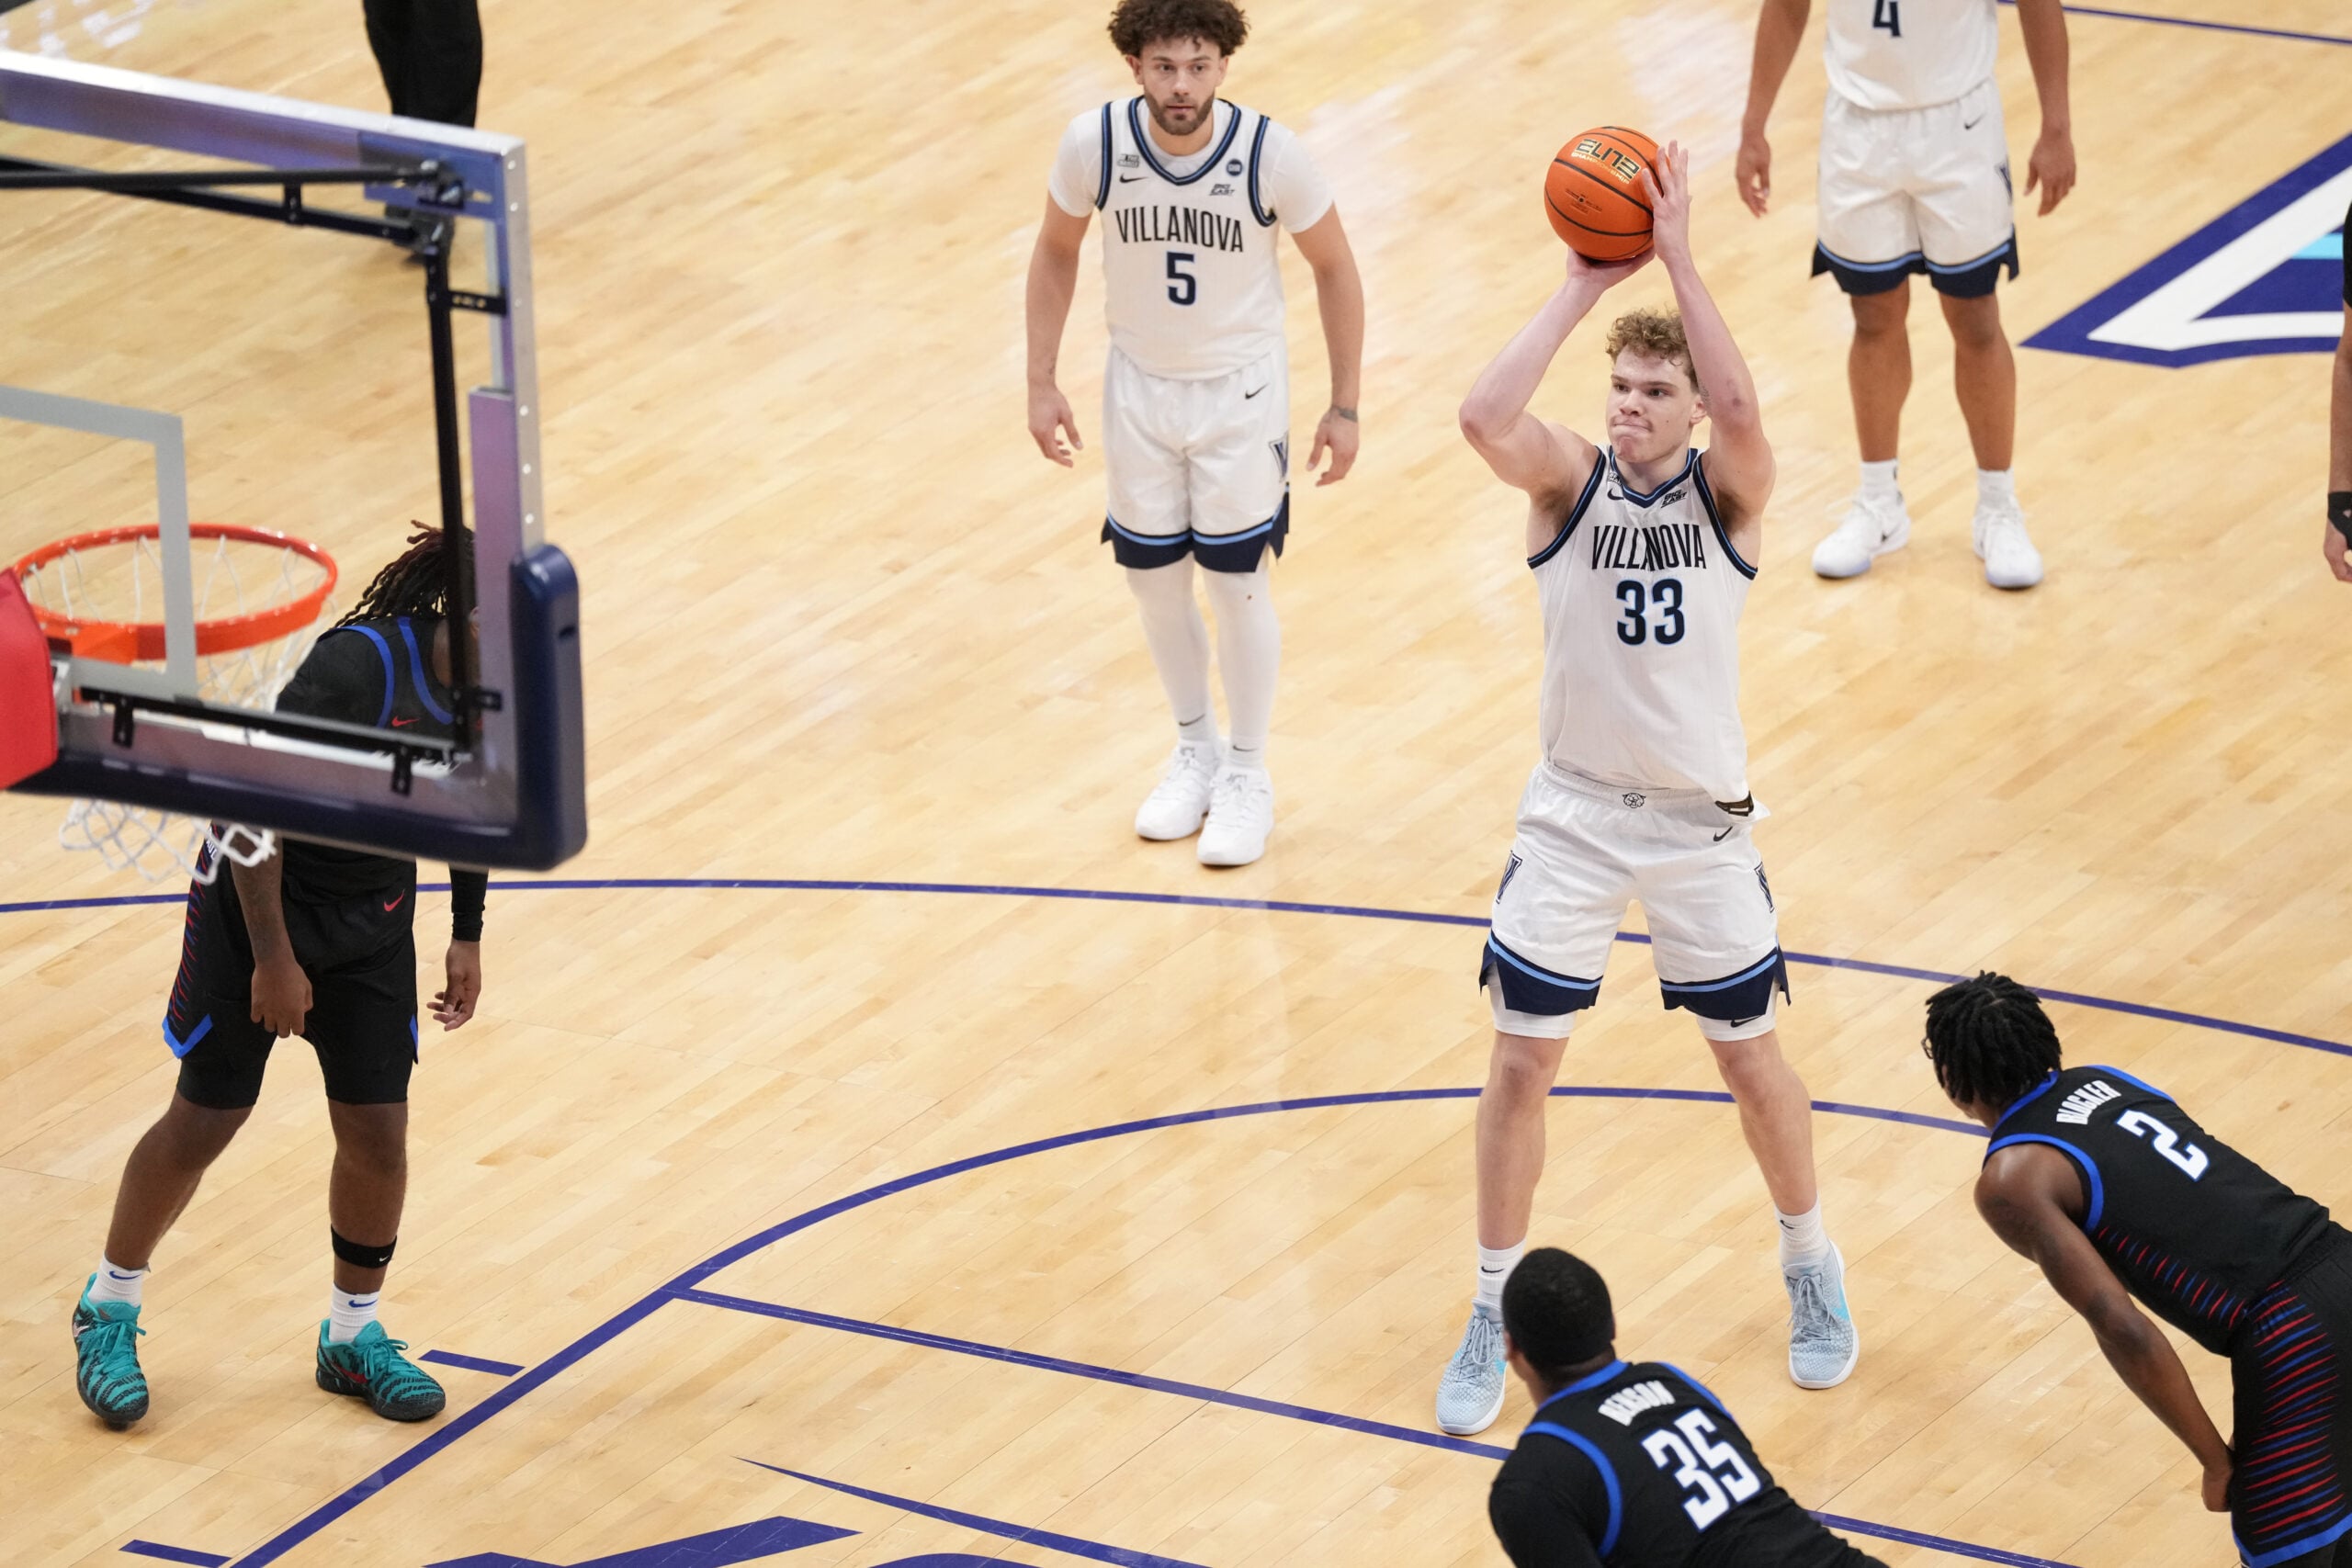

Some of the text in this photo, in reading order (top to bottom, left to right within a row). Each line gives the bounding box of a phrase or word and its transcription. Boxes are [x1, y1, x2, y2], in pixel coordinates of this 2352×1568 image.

[1871, 0, 1901, 37] 4
[1576, 138, 1641, 180] ELITE
[1114, 205, 1244, 253] VILLANOVA
[1166, 251, 1196, 306] 5
[1615, 578, 1686, 647] 33
[2056, 1079, 2122, 1125] BLOCKER
[2116, 1109, 2210, 1182] 2
[1640, 1406, 1762, 1533] 35
